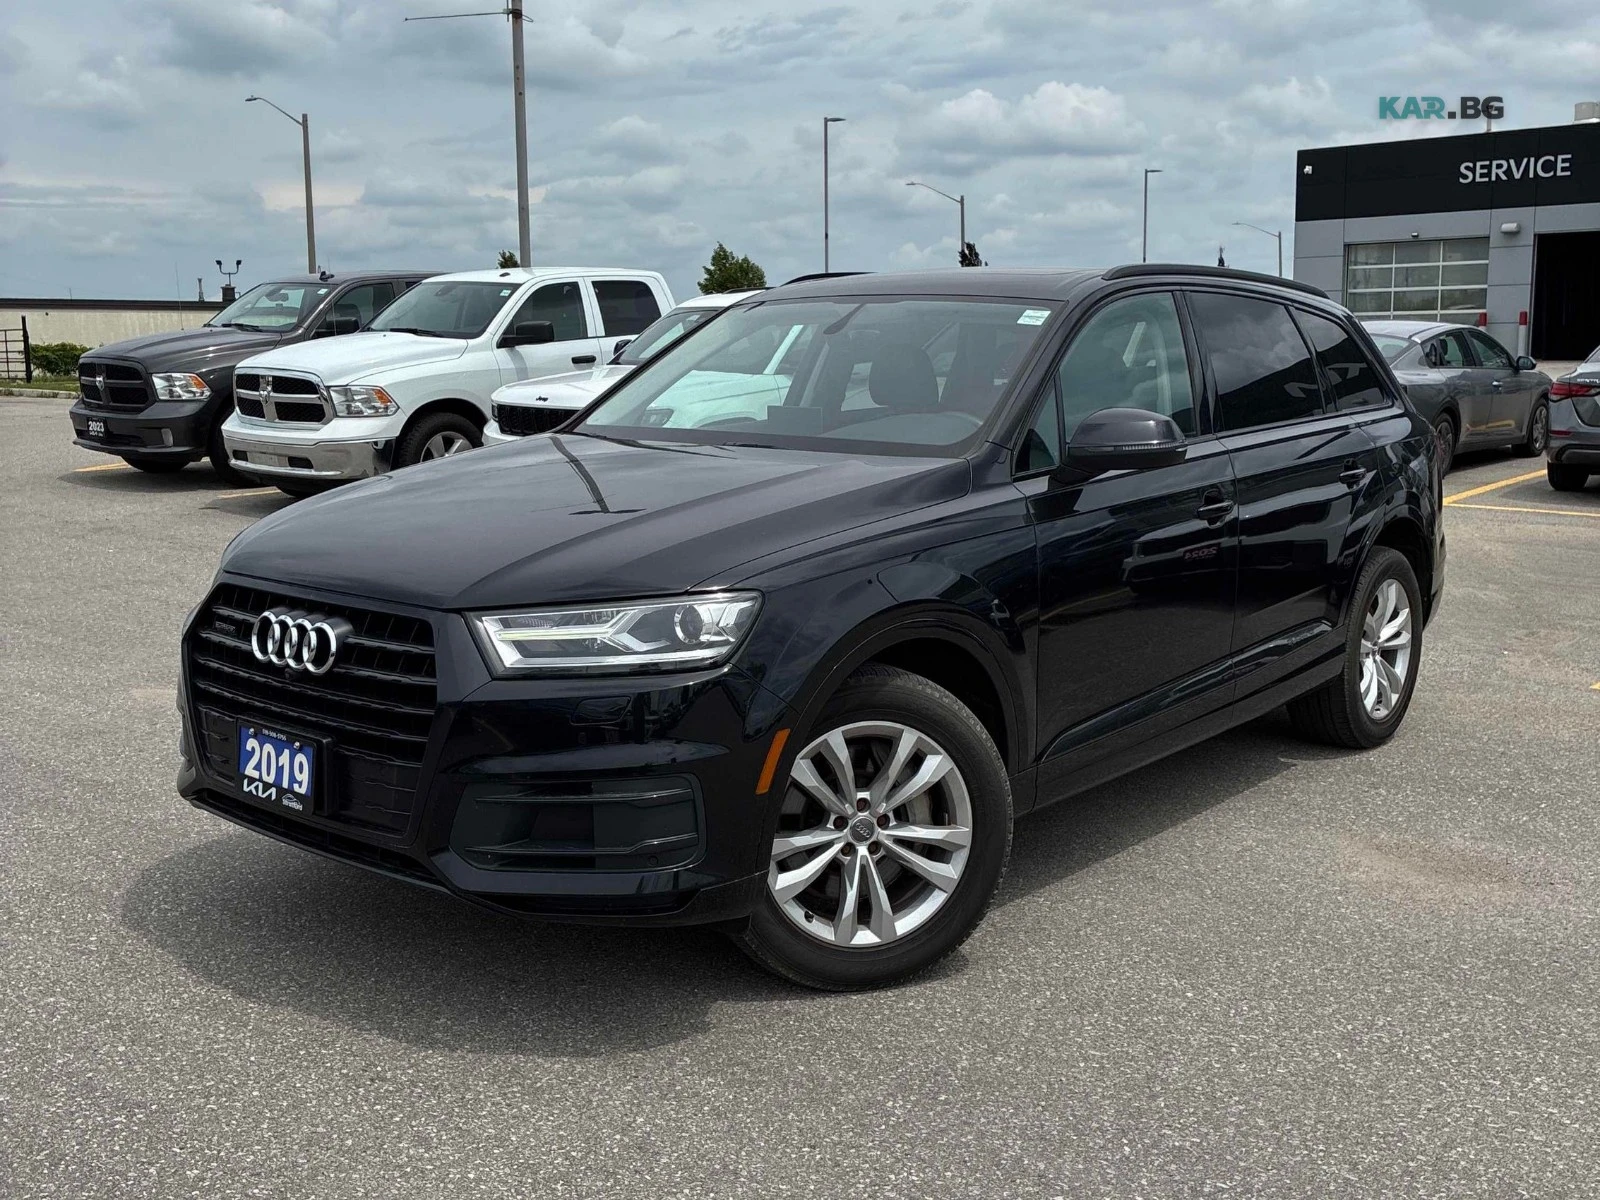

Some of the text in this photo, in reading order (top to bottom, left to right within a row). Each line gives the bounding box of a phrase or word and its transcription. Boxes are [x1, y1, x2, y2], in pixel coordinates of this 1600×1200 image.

[1459, 154, 1572, 183] SERVICE
[88, 421, 104, 432] 2023
[244, 738, 309, 794] 2019
[243, 778, 276, 800] KIA
